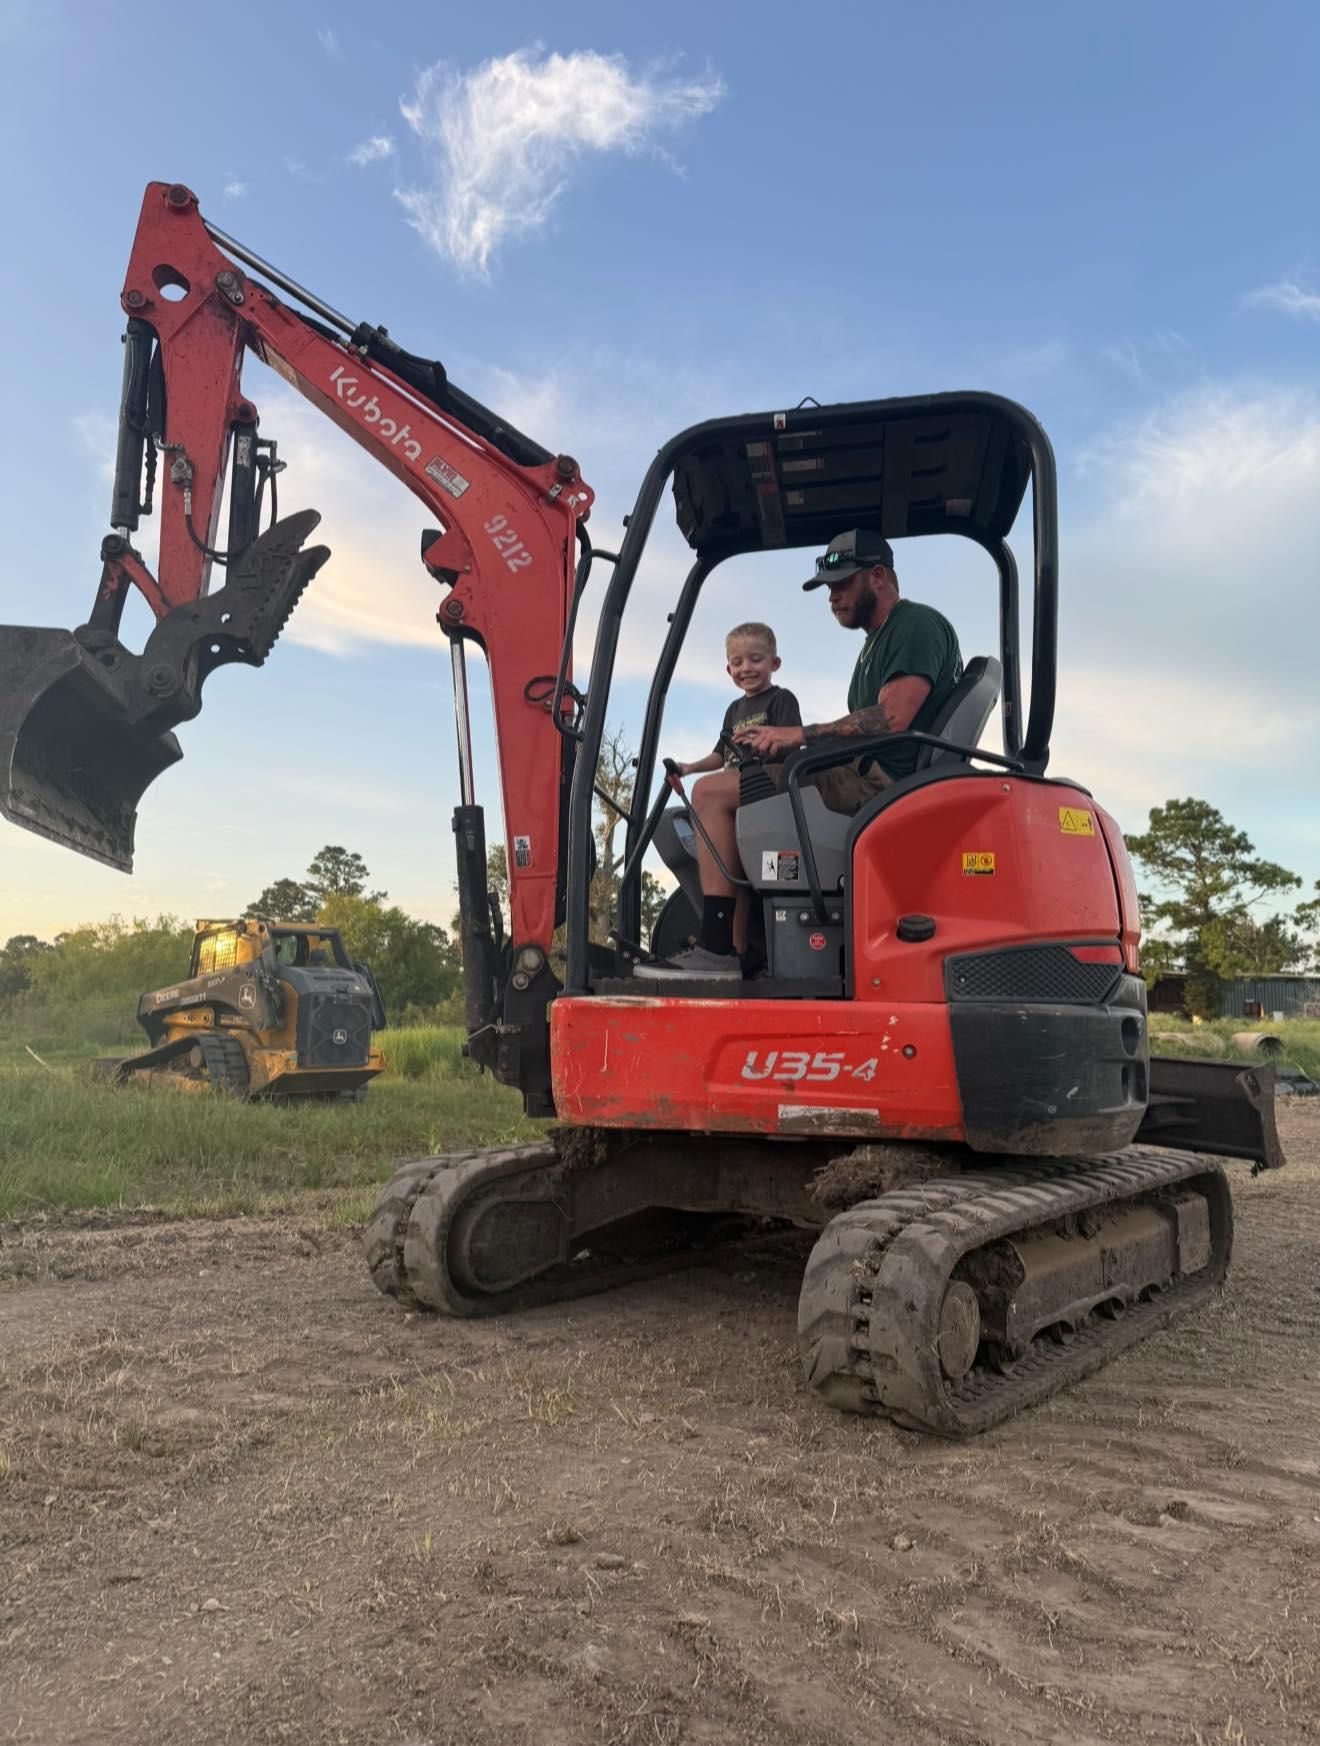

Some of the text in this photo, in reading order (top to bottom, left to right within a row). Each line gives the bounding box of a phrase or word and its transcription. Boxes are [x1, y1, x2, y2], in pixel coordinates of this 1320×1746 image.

[329, 366, 422, 462] Kubota
[484, 513, 533, 574] 9212
[156, 988, 180, 1005] DEERE
[741, 1051, 879, 1081] U35-4
